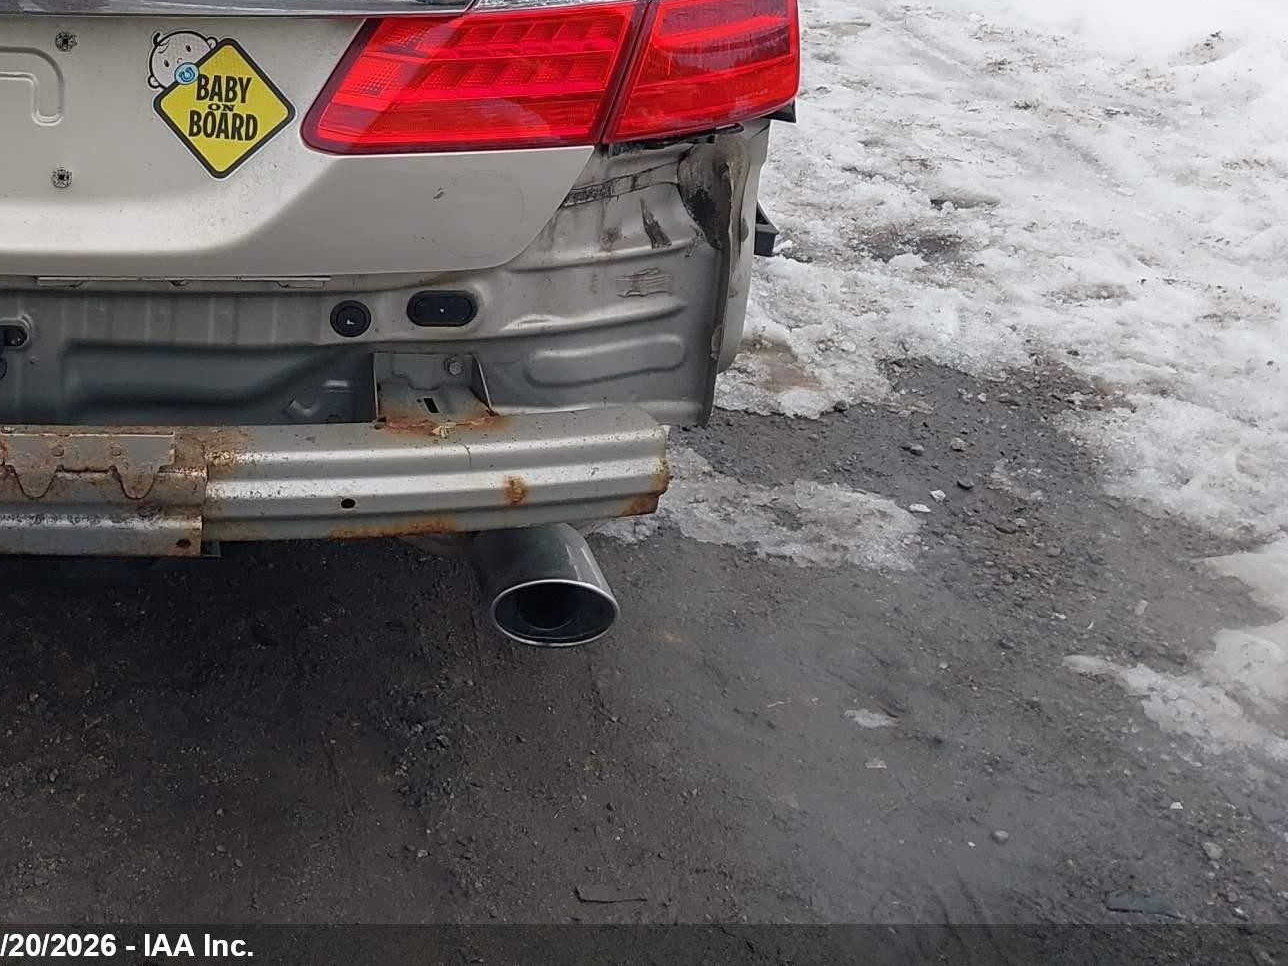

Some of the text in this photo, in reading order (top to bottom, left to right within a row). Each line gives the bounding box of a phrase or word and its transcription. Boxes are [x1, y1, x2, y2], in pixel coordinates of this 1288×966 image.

[196, 74, 252, 103] BABY
[207, 102, 236, 113] ON
[188, 109, 258, 141] BOARD
